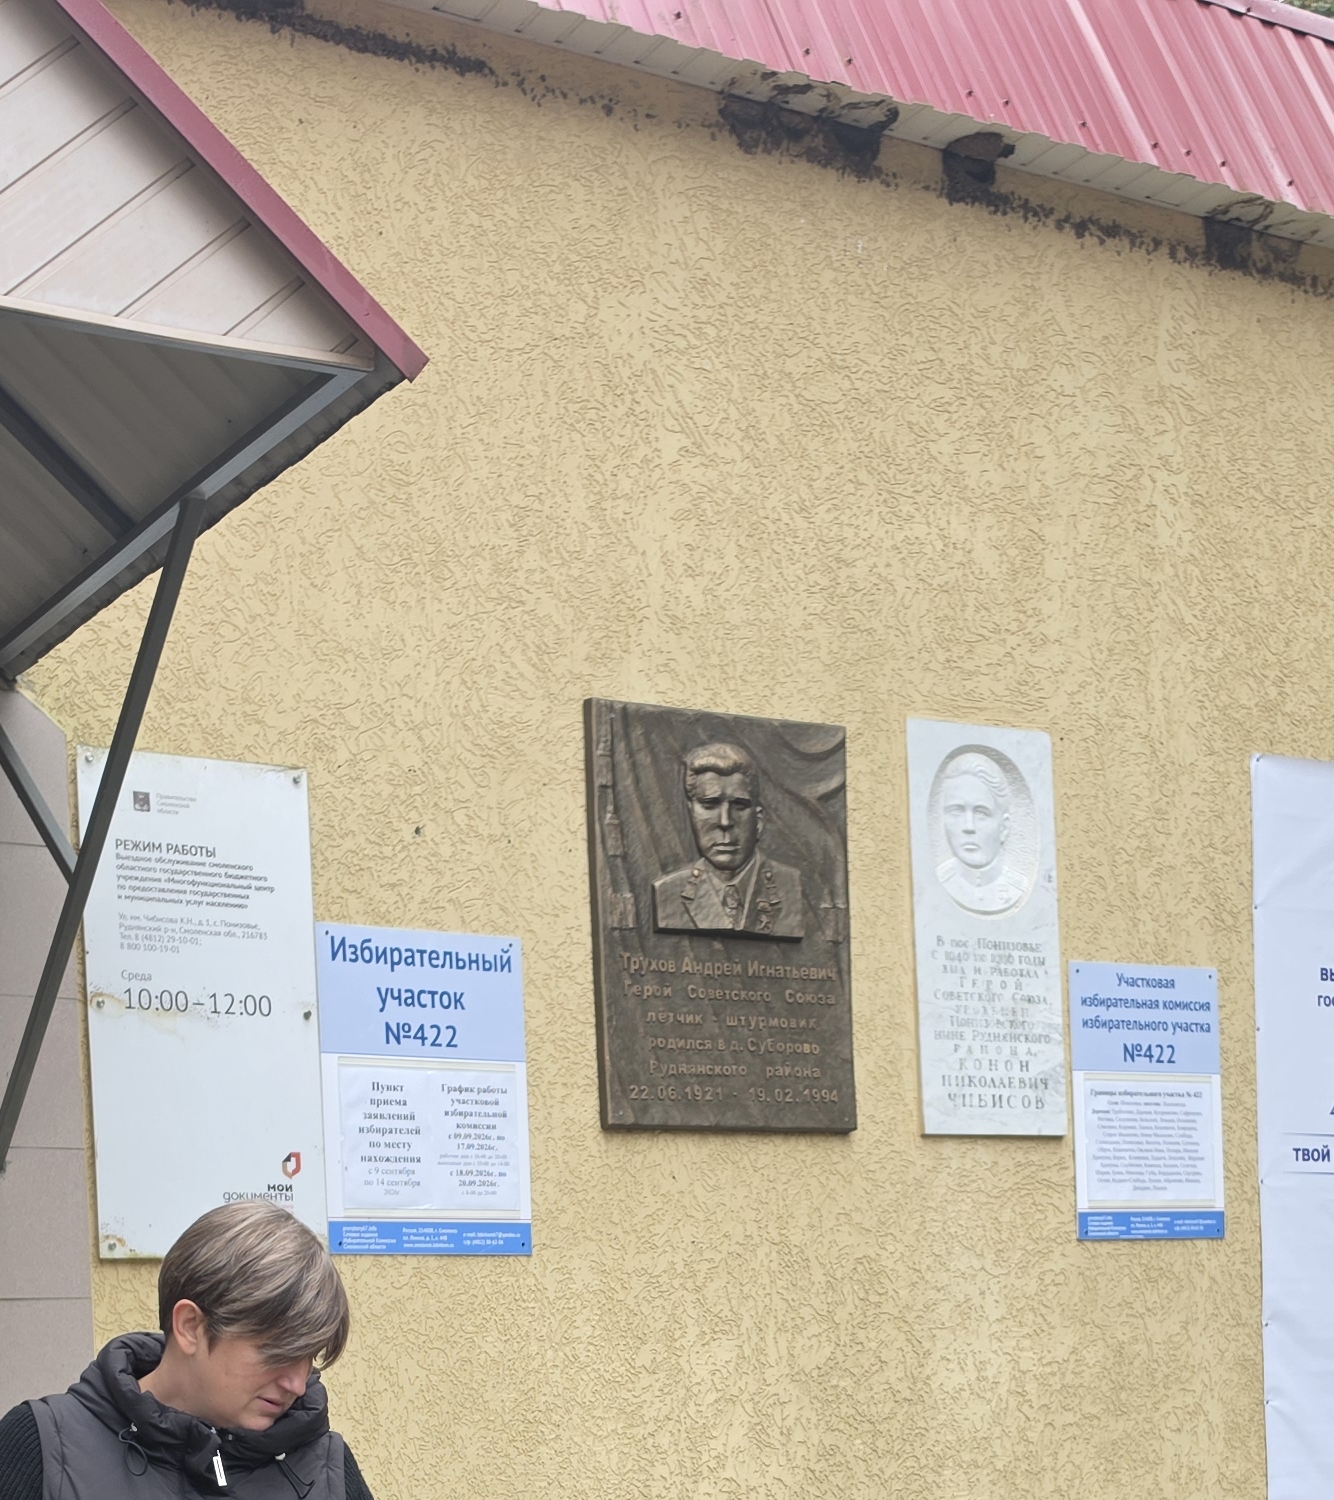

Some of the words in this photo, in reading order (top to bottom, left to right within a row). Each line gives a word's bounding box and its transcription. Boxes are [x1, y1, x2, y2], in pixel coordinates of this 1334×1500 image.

[115, 838, 162, 854] РЕЖИМ
[166, 842, 217, 858] РАБОТЫ
[119, 941, 125, 950] 8
[126, 942, 141, 951] 800
[143, 943, 180, 953] 100-19-01
[330, 935, 512, 973] Избирательный
[619, 951, 676, 977] Трухов
[681, 956, 742, 978] Андрей
[747, 960, 837, 982] Игнатьевич
[121, 969, 152, 983] Среда
[1116, 972, 1176, 989] Участковая
[376, 986, 466, 1013] участок
[624, 979, 672, 999] Герой
[687, 984, 772, 1003] Советского
[784, 989, 836, 1006] Союза
[1080, 993, 1160, 1011] избирательная
[1162, 1000, 1211, 1012] комиссия
[725, 1015, 817, 1031] штурмовик
[1081, 1015, 1169, 1034] избирательного
[1170, 1021, 1211, 1036] участка
[385, 1021, 458, 1048] №422
[649, 1035, 713, 1051] родился
[718, 1040, 726, 1051] в
[1123, 1042, 1176, 1064] №422
[649, 1059, 748, 1078] Руднянского
[765, 1061, 822, 1080] района
[959, 1057, 1030, 1073] КОНОН
[371, 1081, 405, 1094] Пункт
[441, 1083, 475, 1095] График
[477, 1085, 508, 1095] работы
[941, 1074, 1049, 1090] НИКОЛАЕВИЧ
[450, 1097, 500, 1106] участковой
[629, 1084, 724, 1102] 22.06.1921
[748, 1087, 839, 1103] 19.02.1994
[369, 1097, 408, 1109] приема
[362, 1110, 416, 1121] заявлений
[444, 1108, 507, 1119] избирательной
[358, 1124, 421, 1137] избирателей
[456, 1122, 497, 1130] комиссии
[368, 1140, 381, 1149] по
[383, 1141, 413, 1152] месту
[1292, 1144, 1331, 1163] ТВОЙ
[360, 1154, 422, 1165] нахождения
[373, 1166, 380, 1175] 9
[381, 1166, 416, 1178] сентября
[267, 1184, 293, 1192] мои
[364, 1179, 374, 1187] по
[376, 1178, 385, 1187] 14
[387, 1177, 421, 1189] сентября
